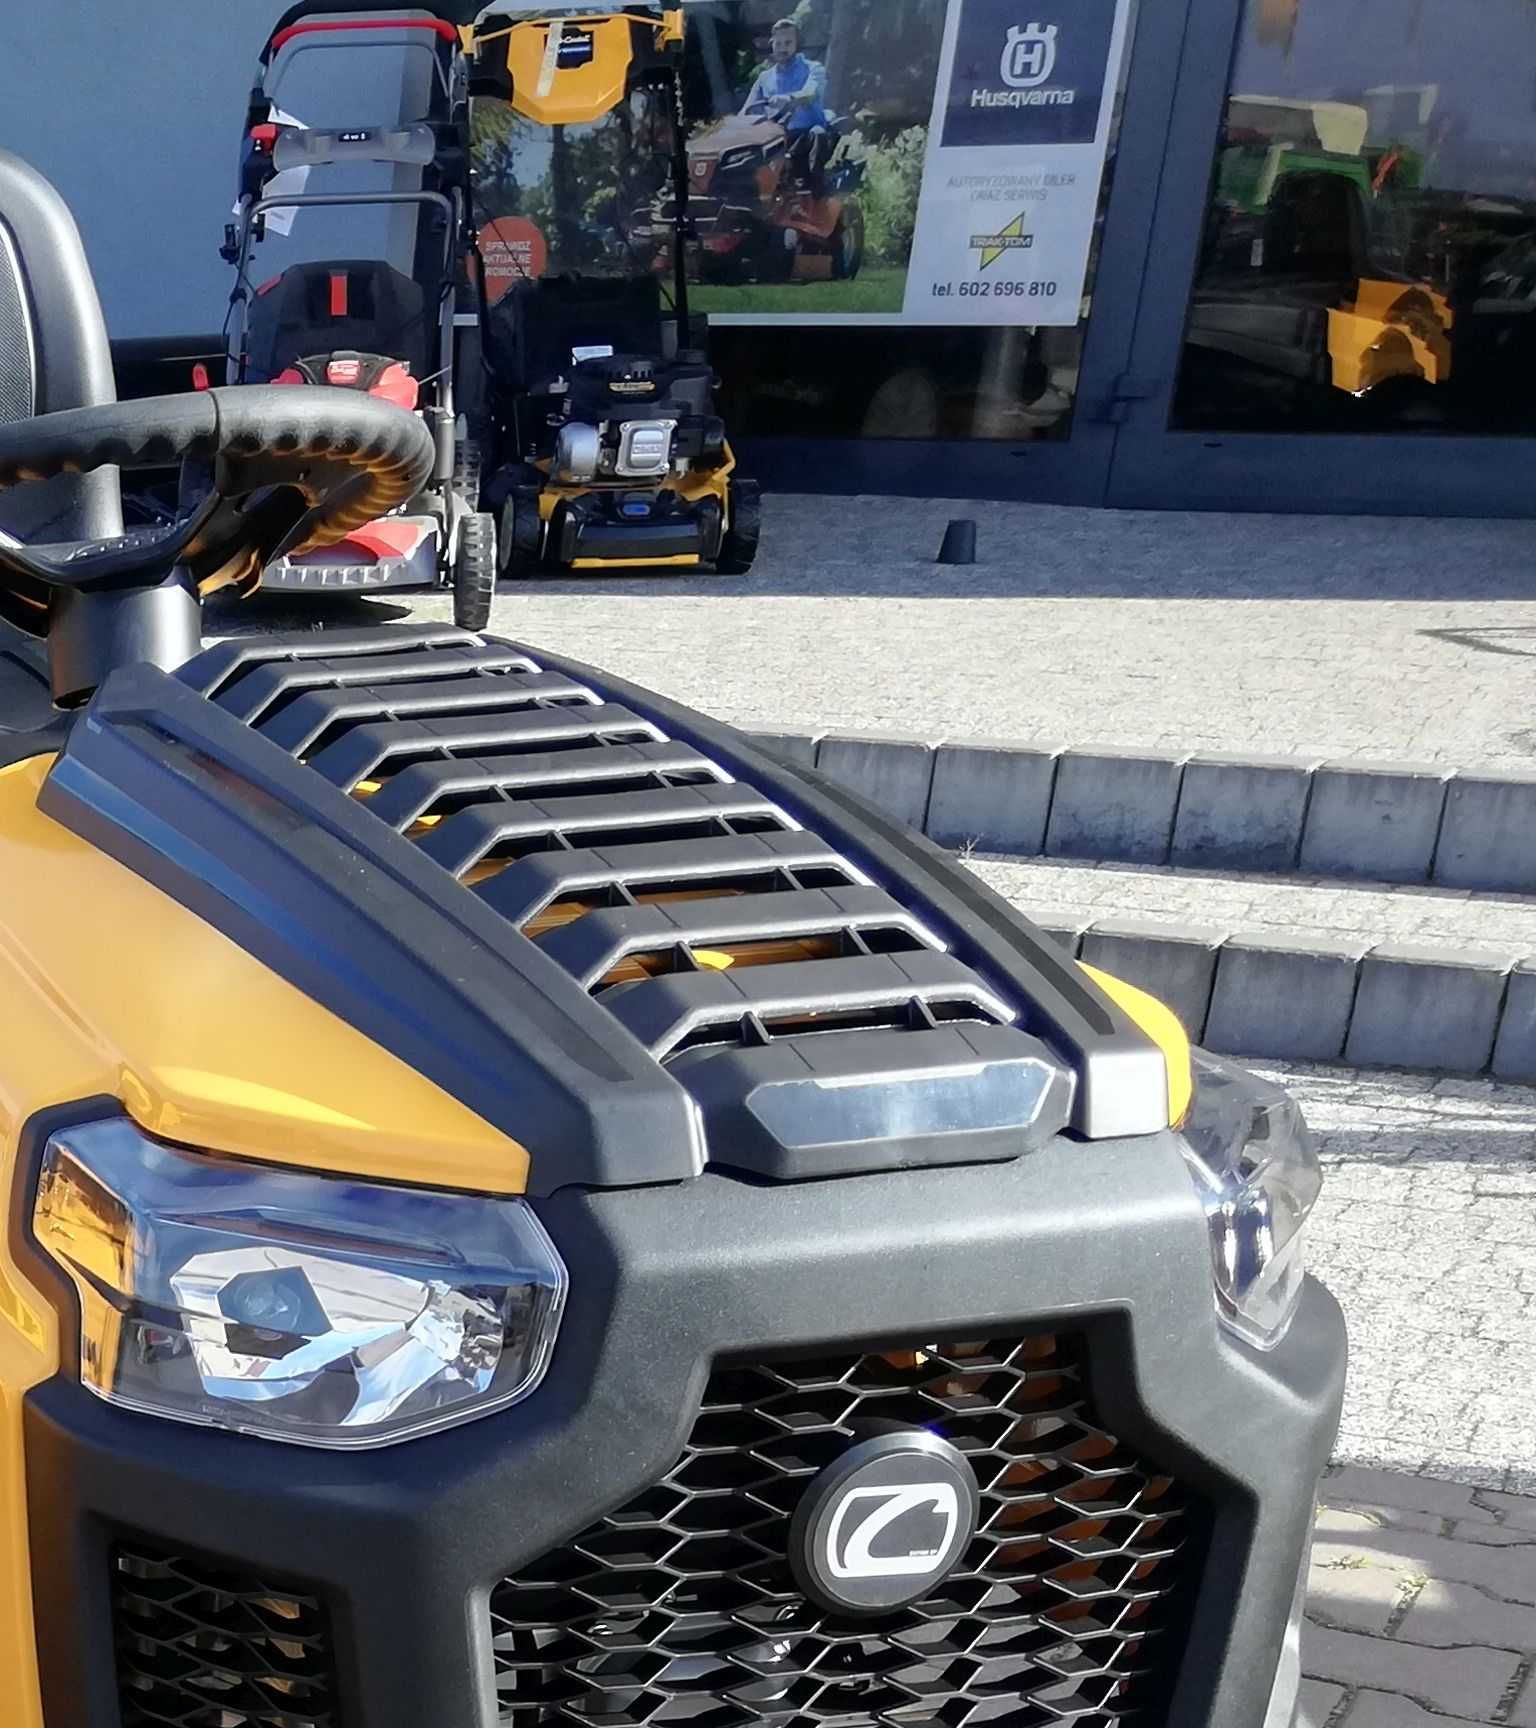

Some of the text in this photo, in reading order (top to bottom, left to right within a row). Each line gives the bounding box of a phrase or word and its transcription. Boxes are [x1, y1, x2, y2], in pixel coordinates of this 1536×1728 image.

[969, 88, 1076, 109] Husqvarna
[932, 281, 1057, 298] tel. 602 696 810
